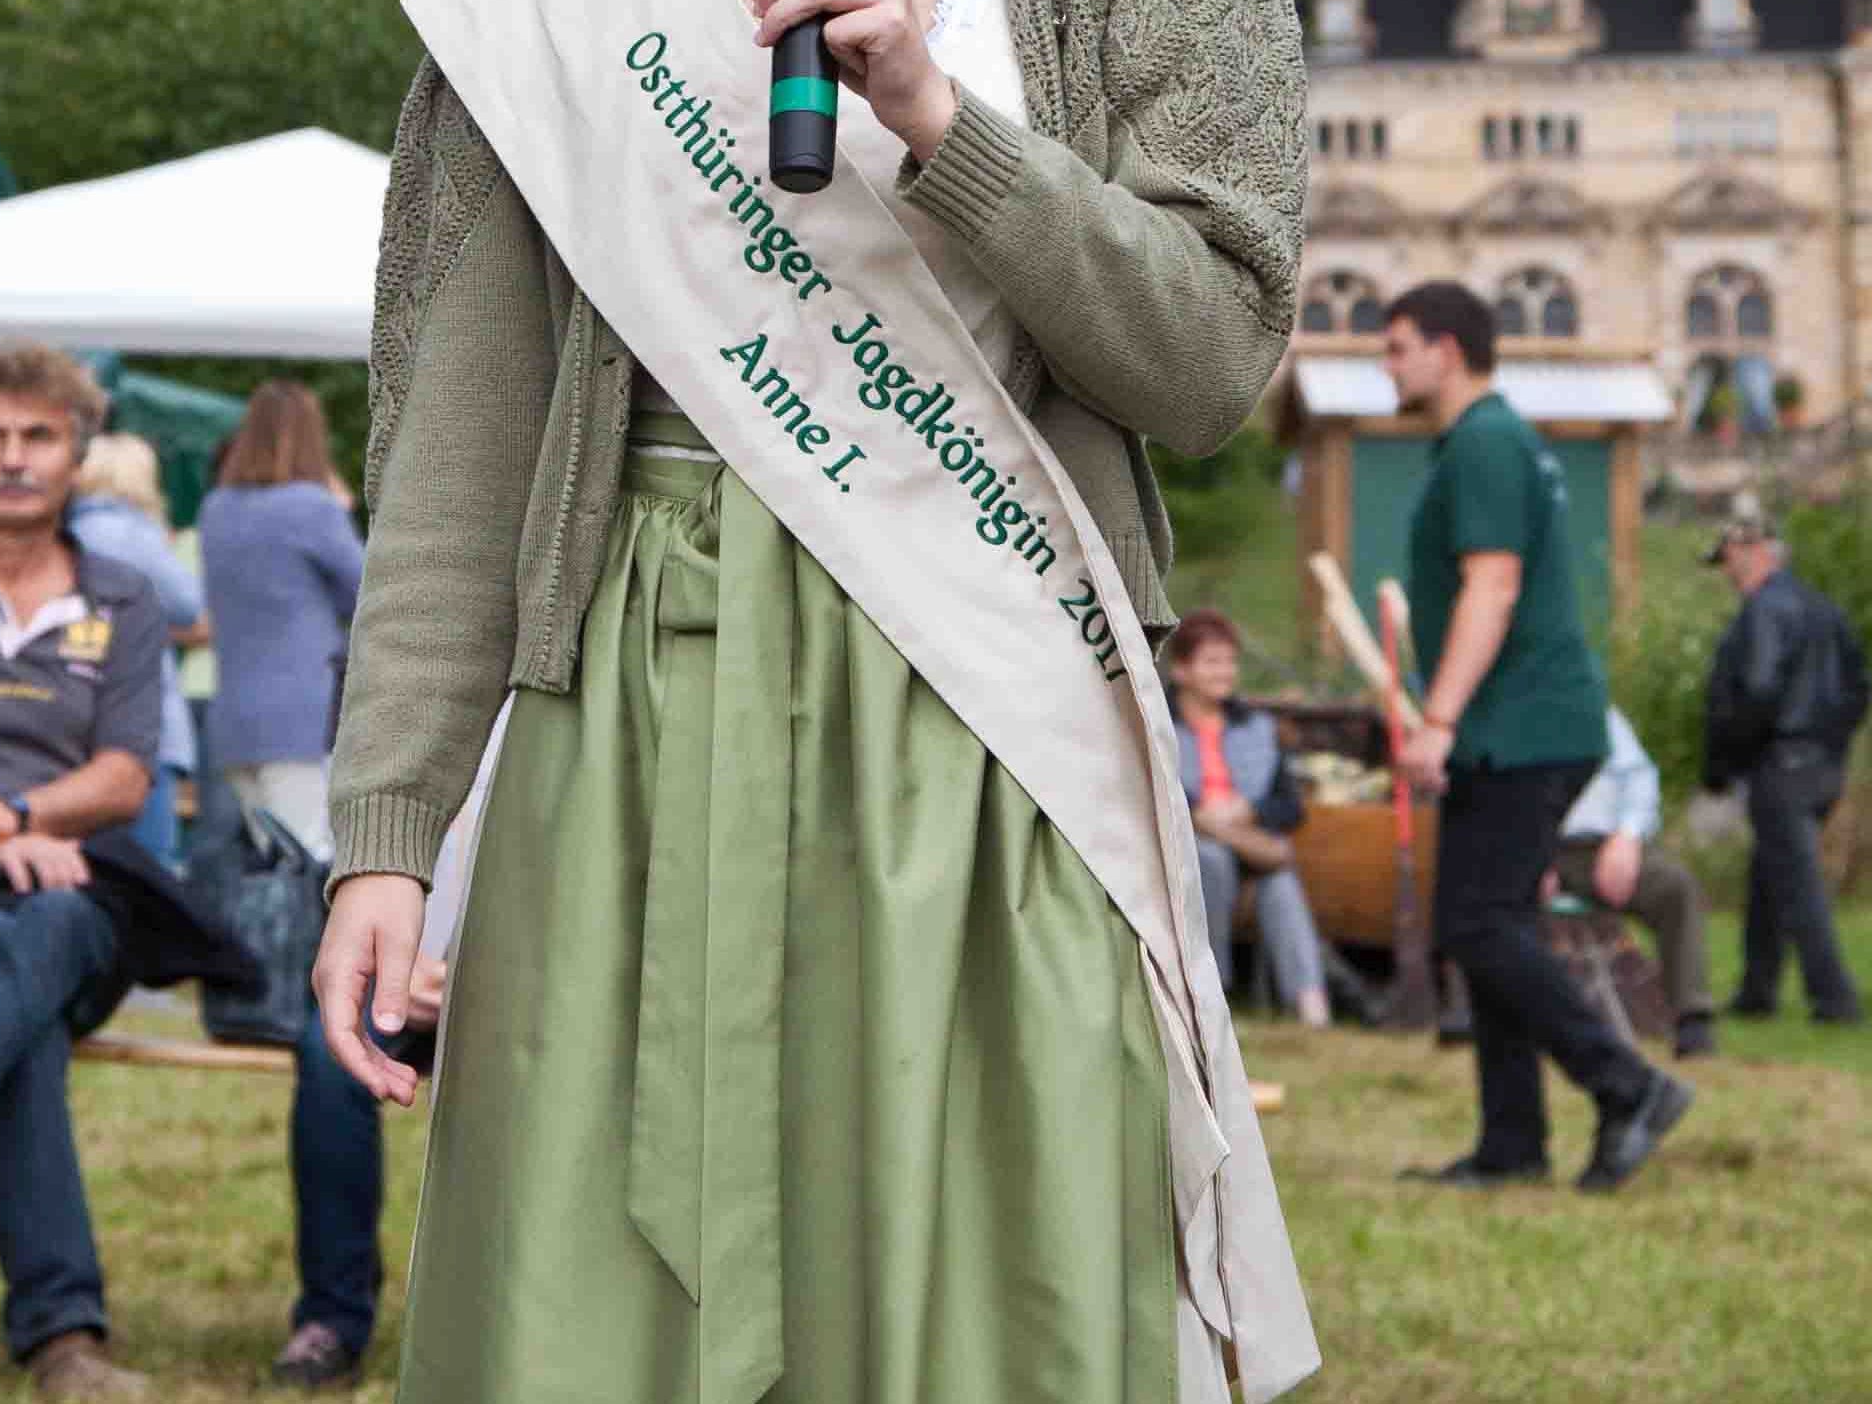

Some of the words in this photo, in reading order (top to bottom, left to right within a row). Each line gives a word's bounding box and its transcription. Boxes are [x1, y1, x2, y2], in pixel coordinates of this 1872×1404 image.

[626, 32, 832, 300] Ostthüringer
[831, 313, 1056, 576] Jagdkönigin
[719, 334, 830, 454] Anne
[822, 444, 867, 494] I.
